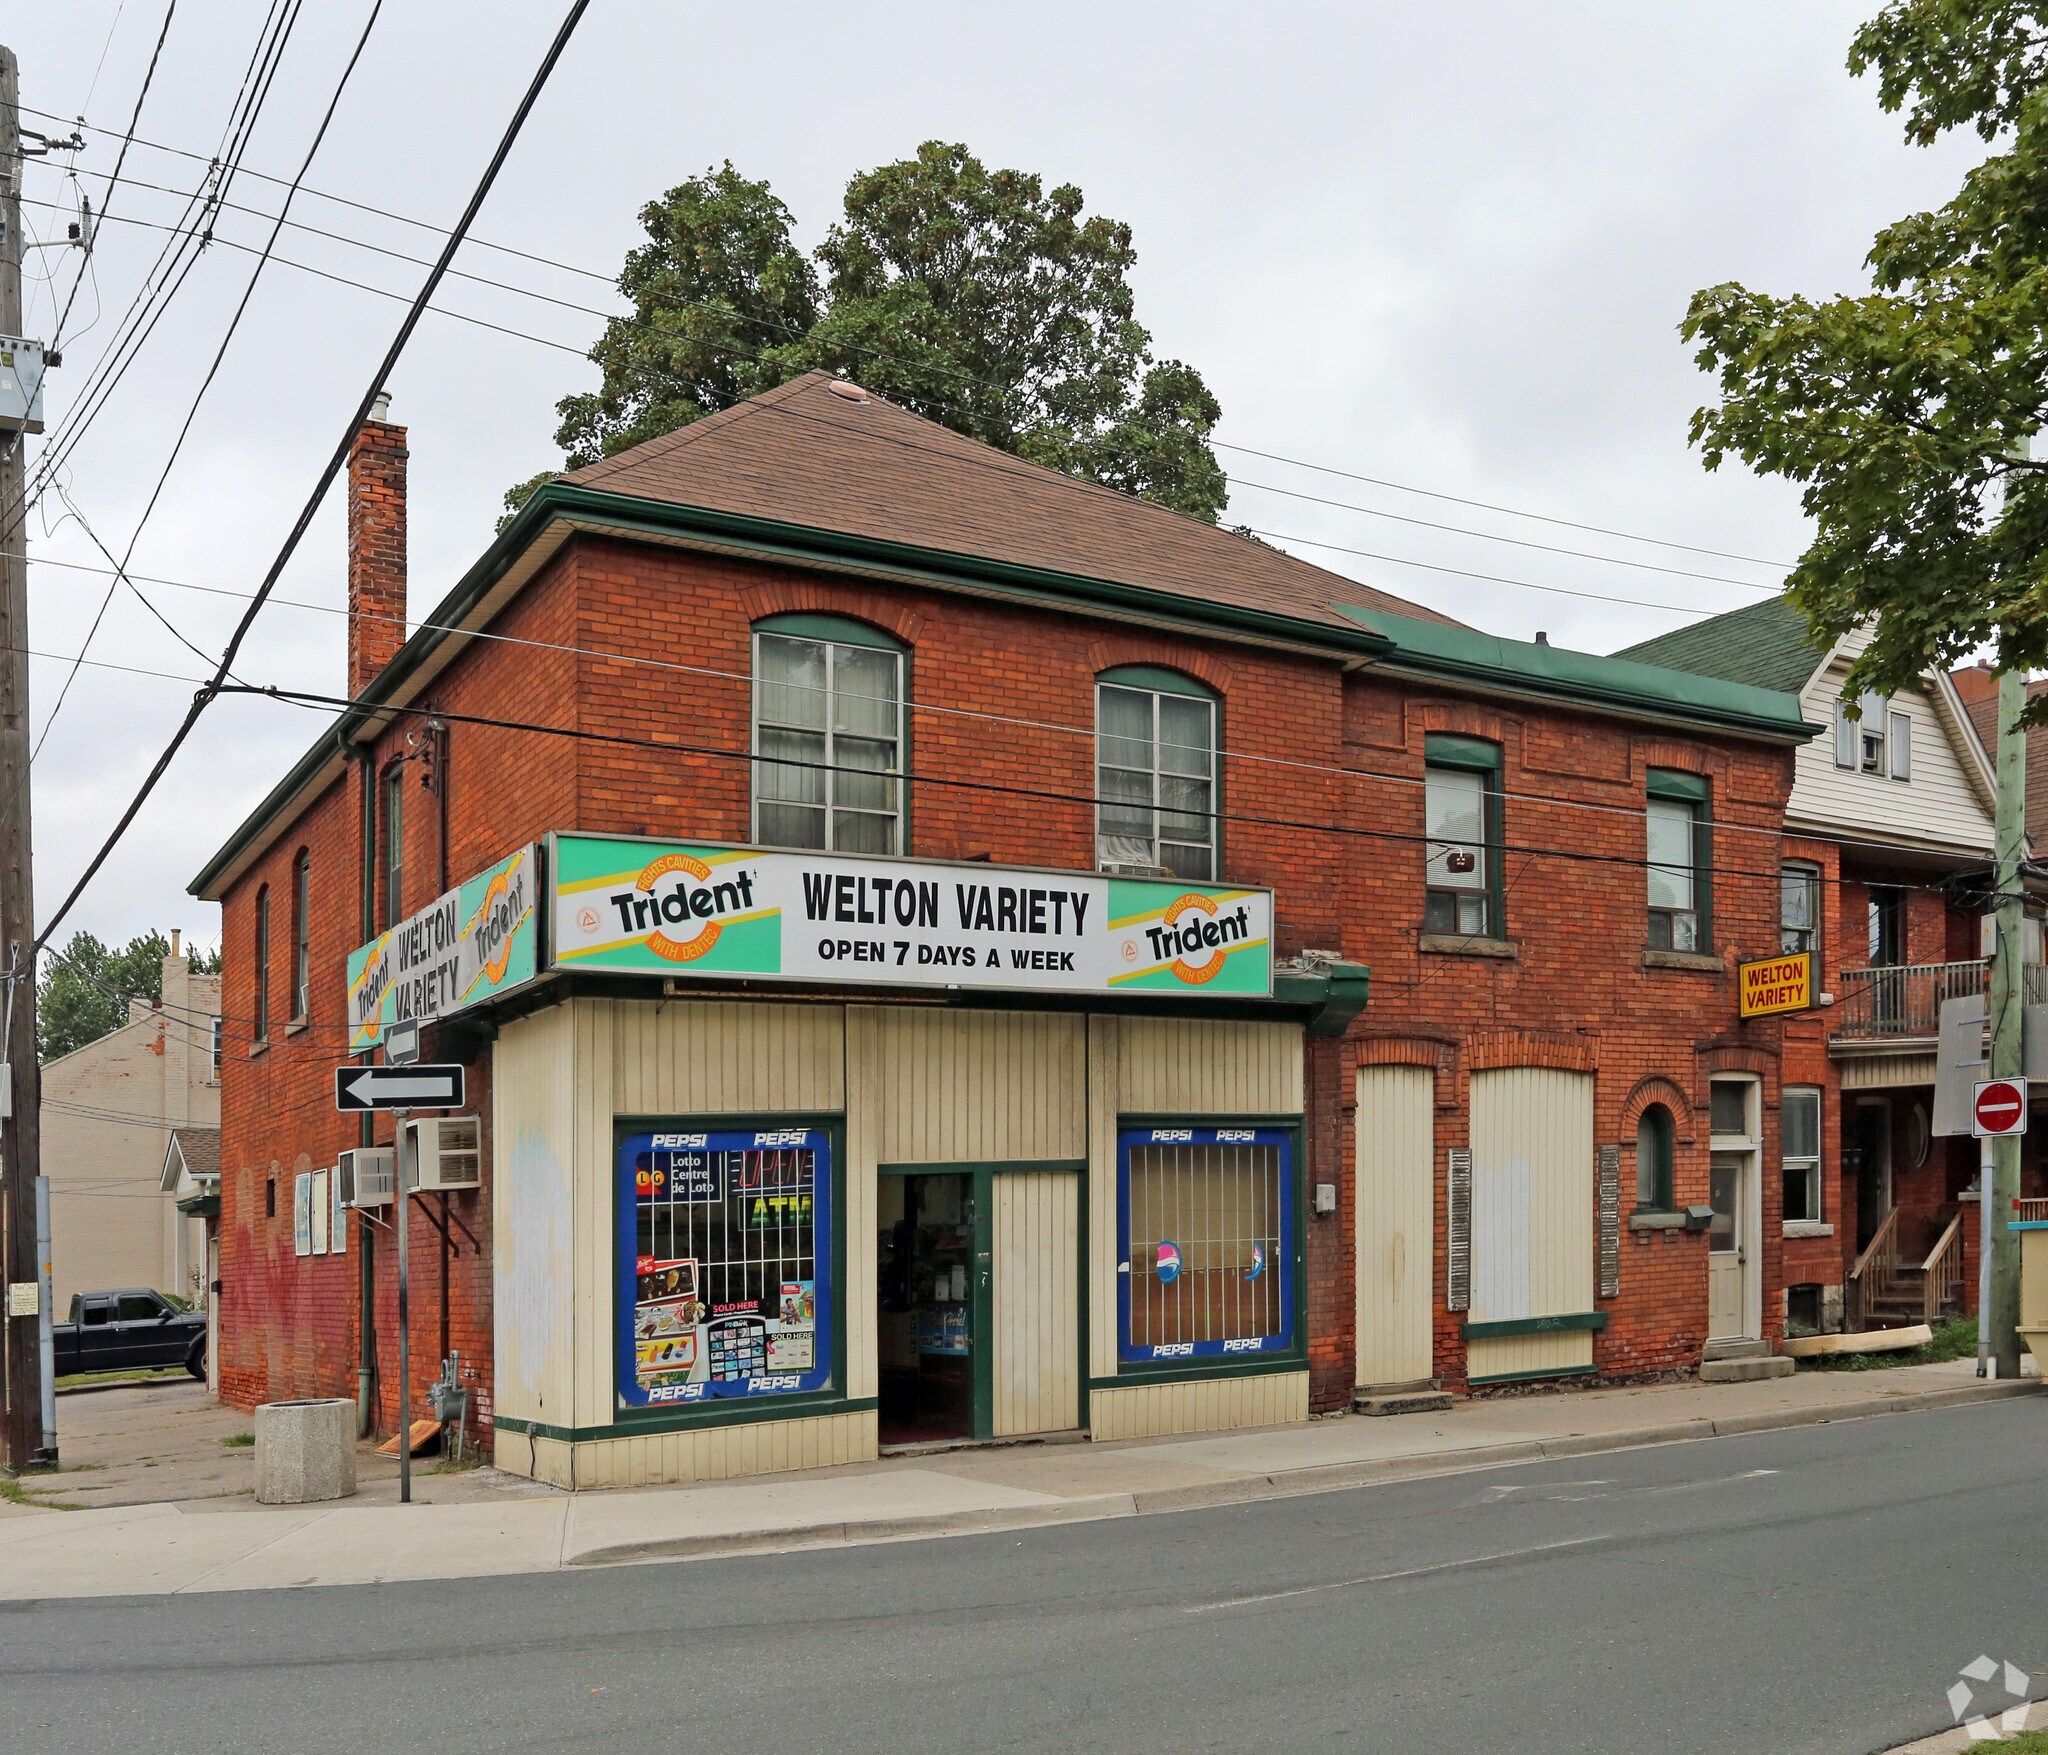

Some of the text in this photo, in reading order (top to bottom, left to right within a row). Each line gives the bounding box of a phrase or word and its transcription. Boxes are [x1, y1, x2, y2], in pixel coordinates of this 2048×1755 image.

[638, 856, 707, 890] FIGHTS CAVITIES
[610, 870, 753, 932] Trident
[802, 872, 1090, 936] WELTON VARIETY
[1165, 895, 1216, 925] FIGHTS CAVITIES
[475, 874, 523, 964] Trident
[398, 900, 456, 973] WELTON
[652, 928, 718, 960] WITH DENTEC
[1145, 906, 1248, 960] Trident
[818, 938, 1075, 972] OPEN 7 DAYS A WEEK
[1175, 956, 1223, 983] WITH DENTEC
[1747, 961, 1803, 988] WELTON
[358, 951, 389, 1022] Trident
[396, 955, 459, 1023] VARIETY
[1746, 983, 1804, 1009] VARIETY
[651, 1134, 707, 1148] PEPSI
[753, 1132, 807, 1147] PEPSI
[1151, 1130, 1192, 1141] PEPSI
[1216, 1130, 1255, 1141] PEPSI
[671, 1169, 709, 1179] Centre
[672, 1157, 701, 1167] Lotto
[672, 1182, 715, 1193] de Loto
[751, 1196, 811, 1225] ATM
[712, 1300, 758, 1313] SOLD HERE
[1152, 1343, 1194, 1357] PEPSI
[1223, 1338, 1263, 1352] PEPSI
[648, 1383, 704, 1402] PEPSI
[748, 1375, 801, 1391] PEPSI
